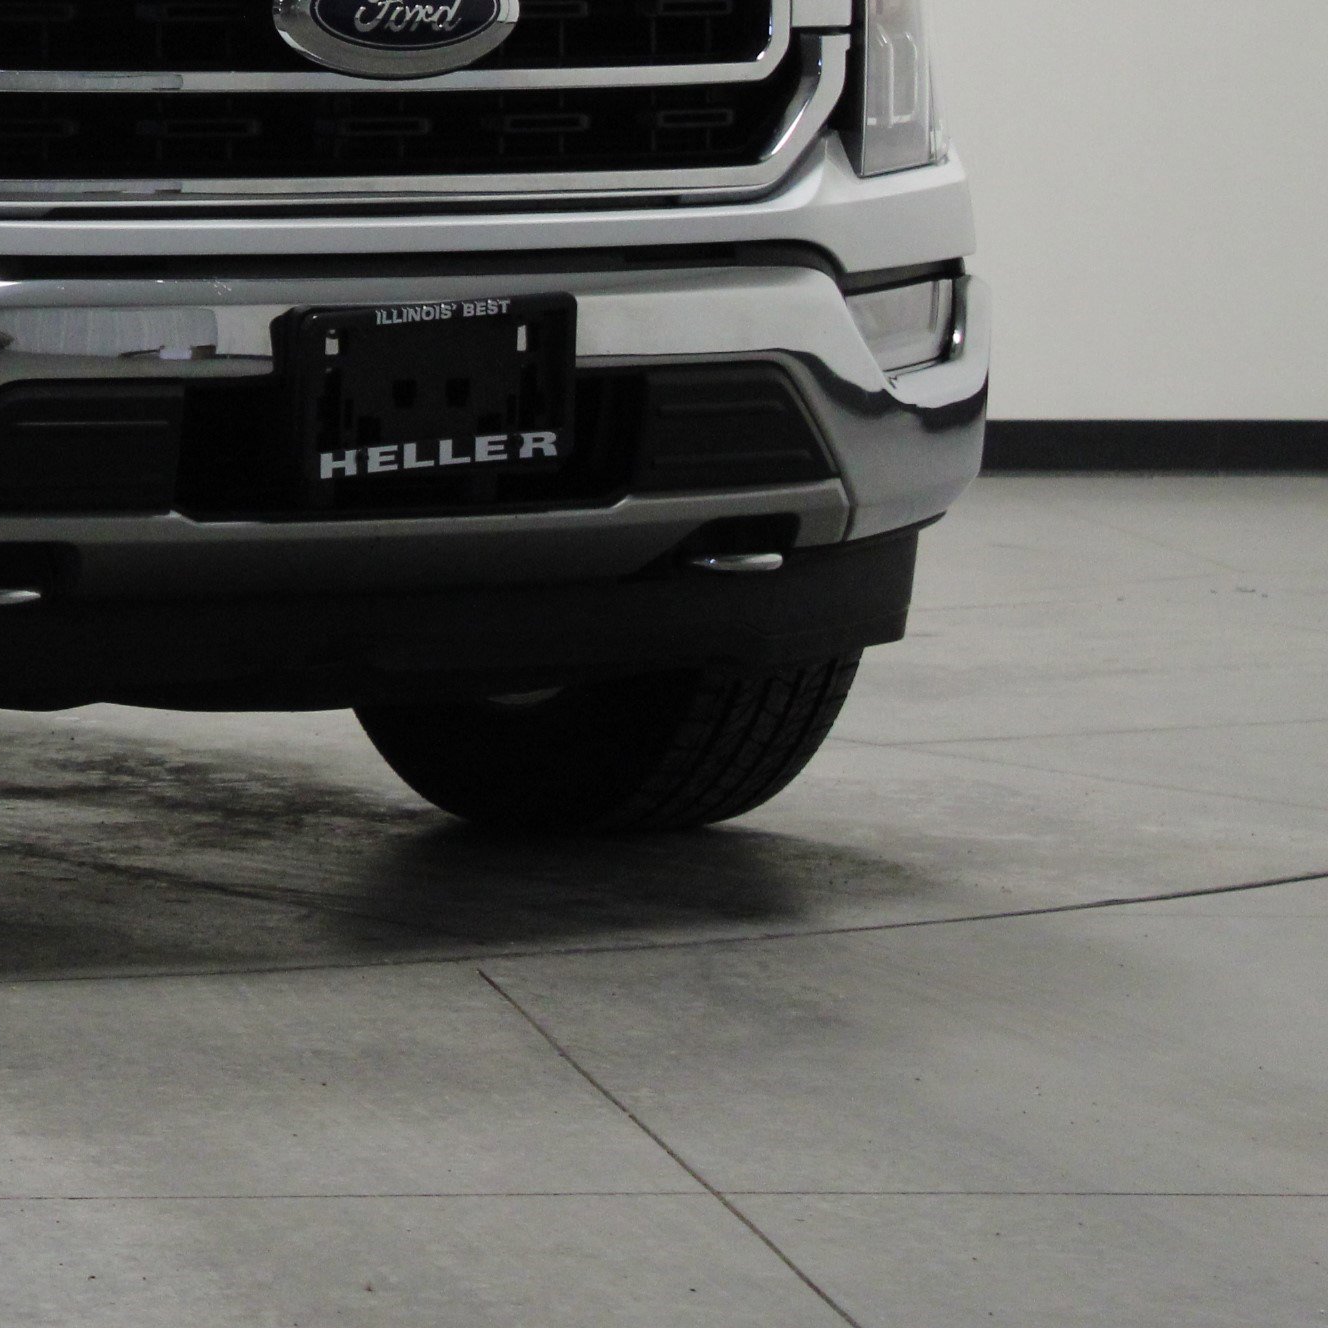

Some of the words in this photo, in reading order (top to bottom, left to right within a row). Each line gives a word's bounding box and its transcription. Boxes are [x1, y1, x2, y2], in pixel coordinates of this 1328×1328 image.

[375, 304, 456, 325] ILLINOIS'
[462, 299, 511, 318] BEST
[320, 431, 557, 479] HELLER
